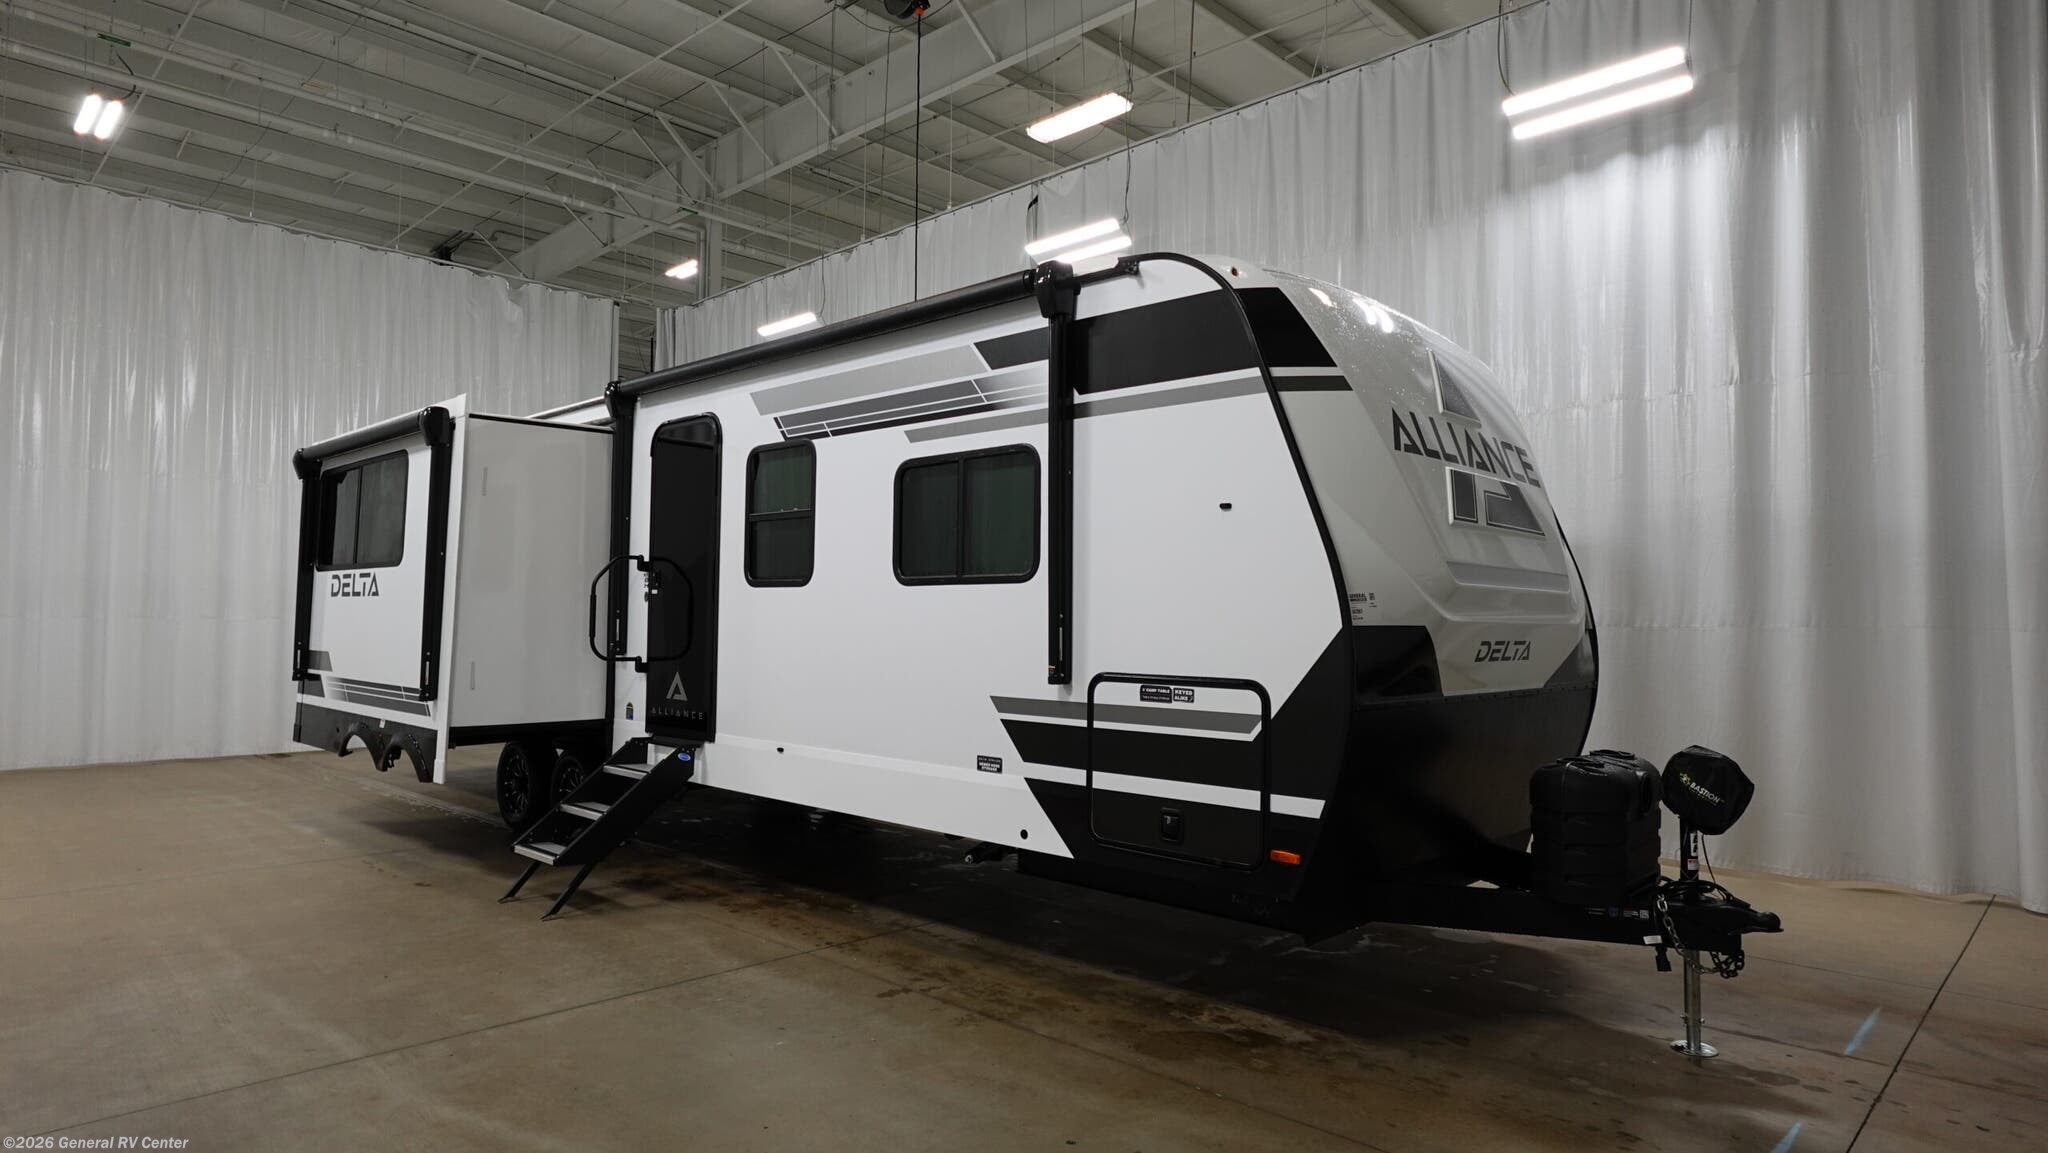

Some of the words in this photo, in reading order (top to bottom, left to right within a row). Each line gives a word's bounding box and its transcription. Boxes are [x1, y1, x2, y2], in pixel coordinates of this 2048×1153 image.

[1392, 407, 1541, 488] ALLIANCE
[331, 572, 379, 597] DELTA
[1474, 640, 1531, 662] DELTA
[651, 707, 704, 720] ALLIANCE
[1690, 782, 1721, 803] BASTION
